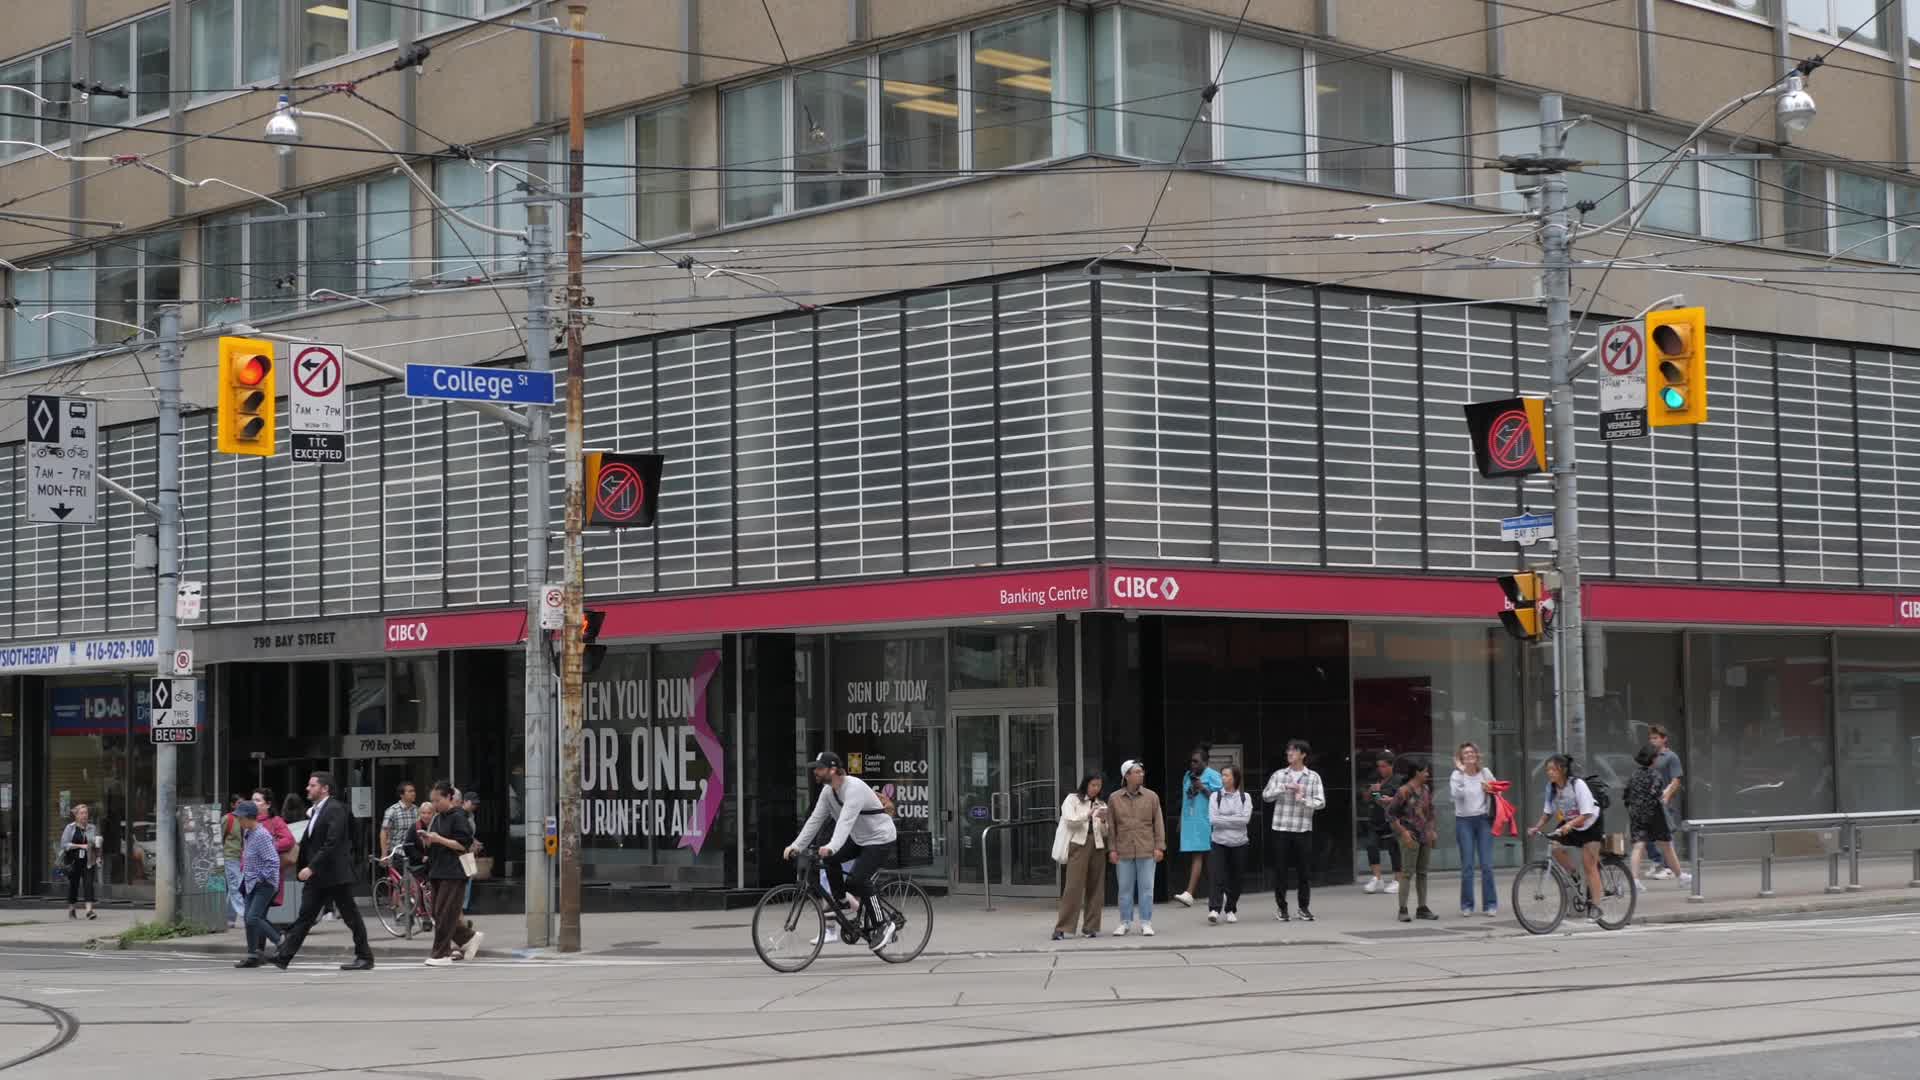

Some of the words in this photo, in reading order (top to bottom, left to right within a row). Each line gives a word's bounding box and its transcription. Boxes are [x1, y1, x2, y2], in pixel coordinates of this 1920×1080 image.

[433, 369, 512, 399] College
[518, 374, 528, 386] St
[295, 404, 311, 415] 7AM
[325, 406, 341, 416] 7PM
[1608, 421, 1641, 429] VEHICLES
[1606, 429, 1642, 438] EXCEPTED
[308, 437, 328, 448] TTC
[294, 449, 342, 459] EXCEPTED
[34, 466, 53, 479] 7AM
[72, 467, 91, 480] 7PM
[38, 485, 87, 497] MON-FRI
[1114, 576, 1158, 598] CIBC
[1000, 589, 1045, 605] Banking
[1048, 586, 1088, 601] Centre
[1901, 601, 1920, 618] CIB
[253, 636, 271, 649] 790
[275, 634, 294, 648] BAY
[298, 632, 336, 646] STREET
[388, 624, 416, 641] CIBC
[0, 645, 59, 667] SIOTHERAPY
[86, 640, 154, 660] 416-929-1900
[615, 680, 648, 720] YOU
[657, 677, 696, 719] RUN
[848, 681, 872, 703] SIGN
[876, 681, 890, 702] UP
[894, 680, 928, 702] TODAY
[174, 710, 190, 718] THIS
[848, 712, 868, 734] OCT
[360, 739, 375, 752] 790
[377, 739, 392, 753] Bay
[393, 739, 416, 751] Street
[580, 728, 619, 791] OR
[893, 760, 917, 773] CIBC
[896, 785, 928, 801] RUN
[595, 800, 629, 836] RUN
[671, 800, 702, 836] ALL
[897, 805, 928, 818] CURE
